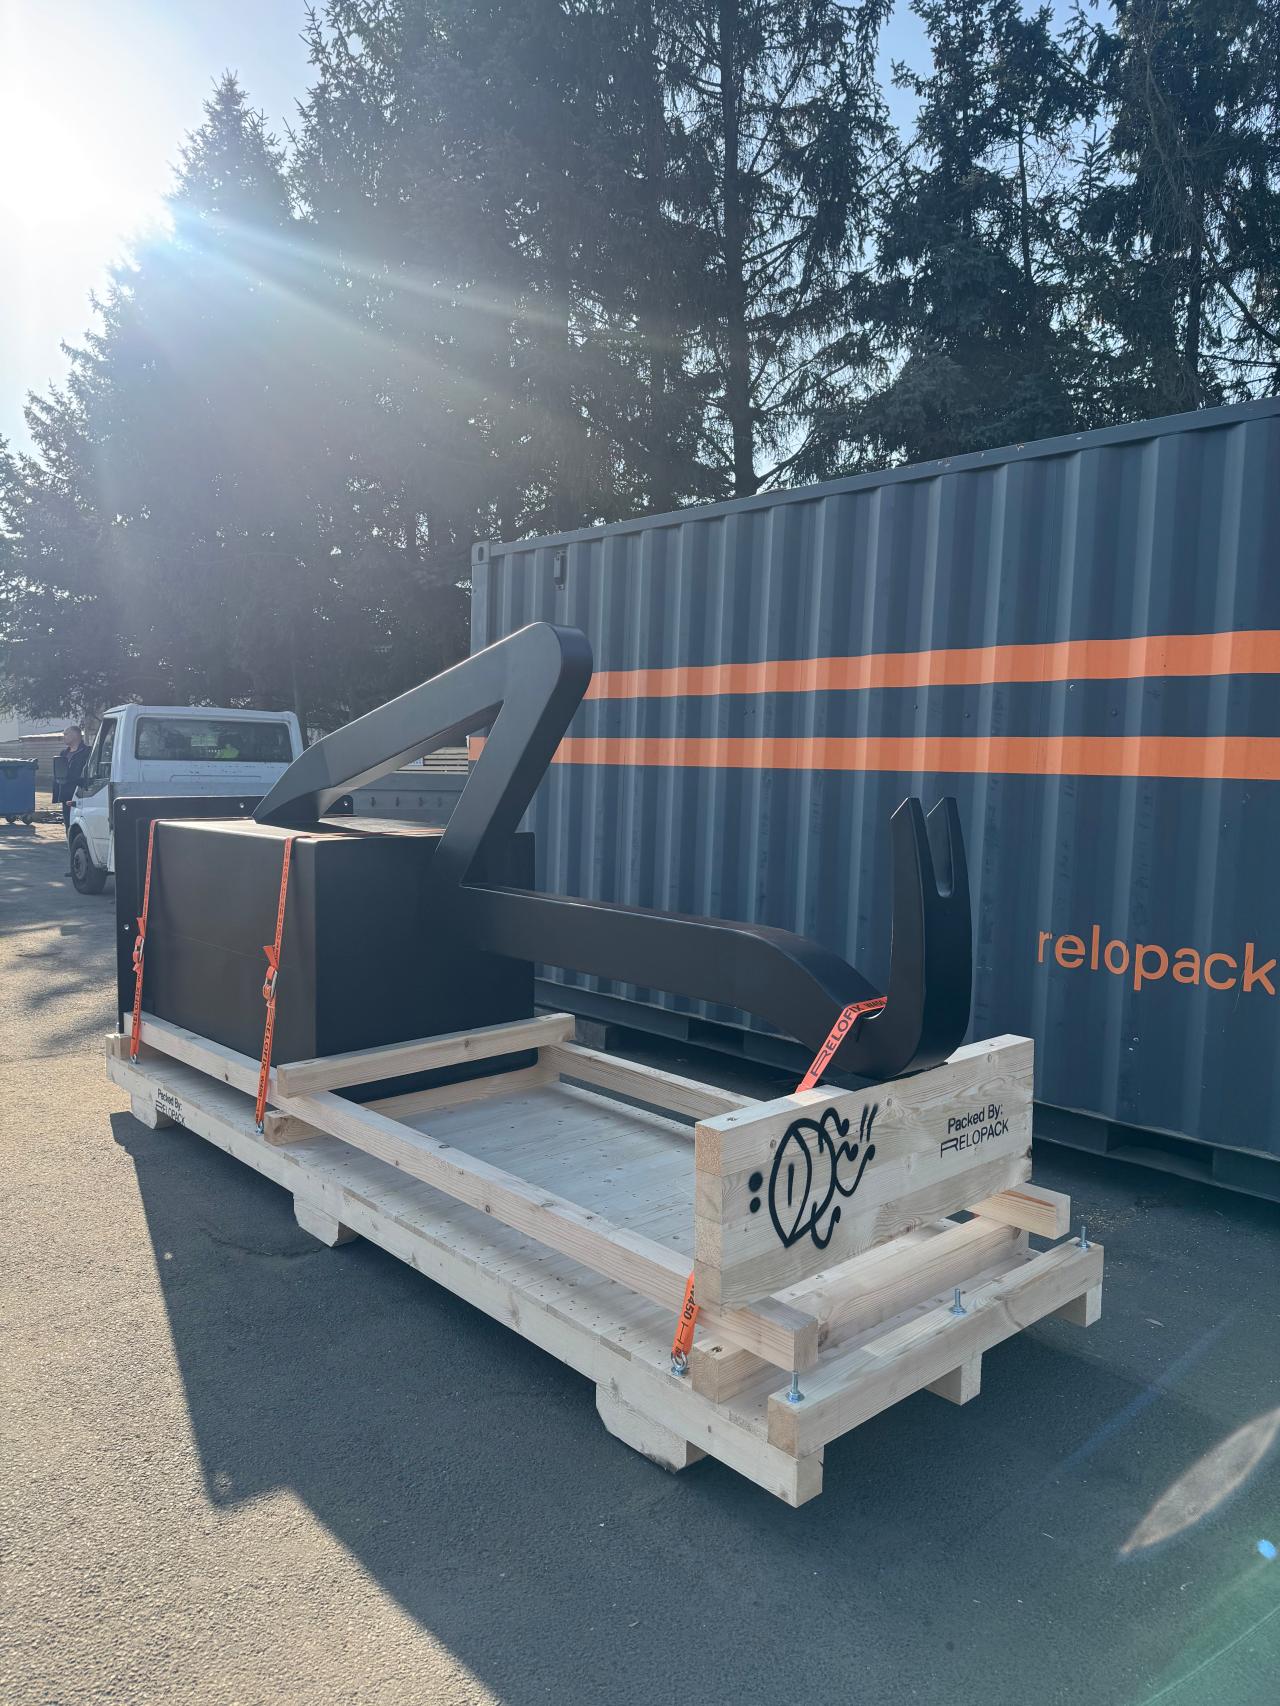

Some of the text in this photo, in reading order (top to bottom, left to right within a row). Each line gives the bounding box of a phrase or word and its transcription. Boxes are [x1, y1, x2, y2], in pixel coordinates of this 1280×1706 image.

[1037, 924, 1277, 995] relopack
[809, 1004, 864, 1078] RELOFIX
[157, 1087, 175, 1106] Packed
[940, 1117, 1010, 1159] RELOPACK
[948, 1103, 1004, 1134] Packed By:
